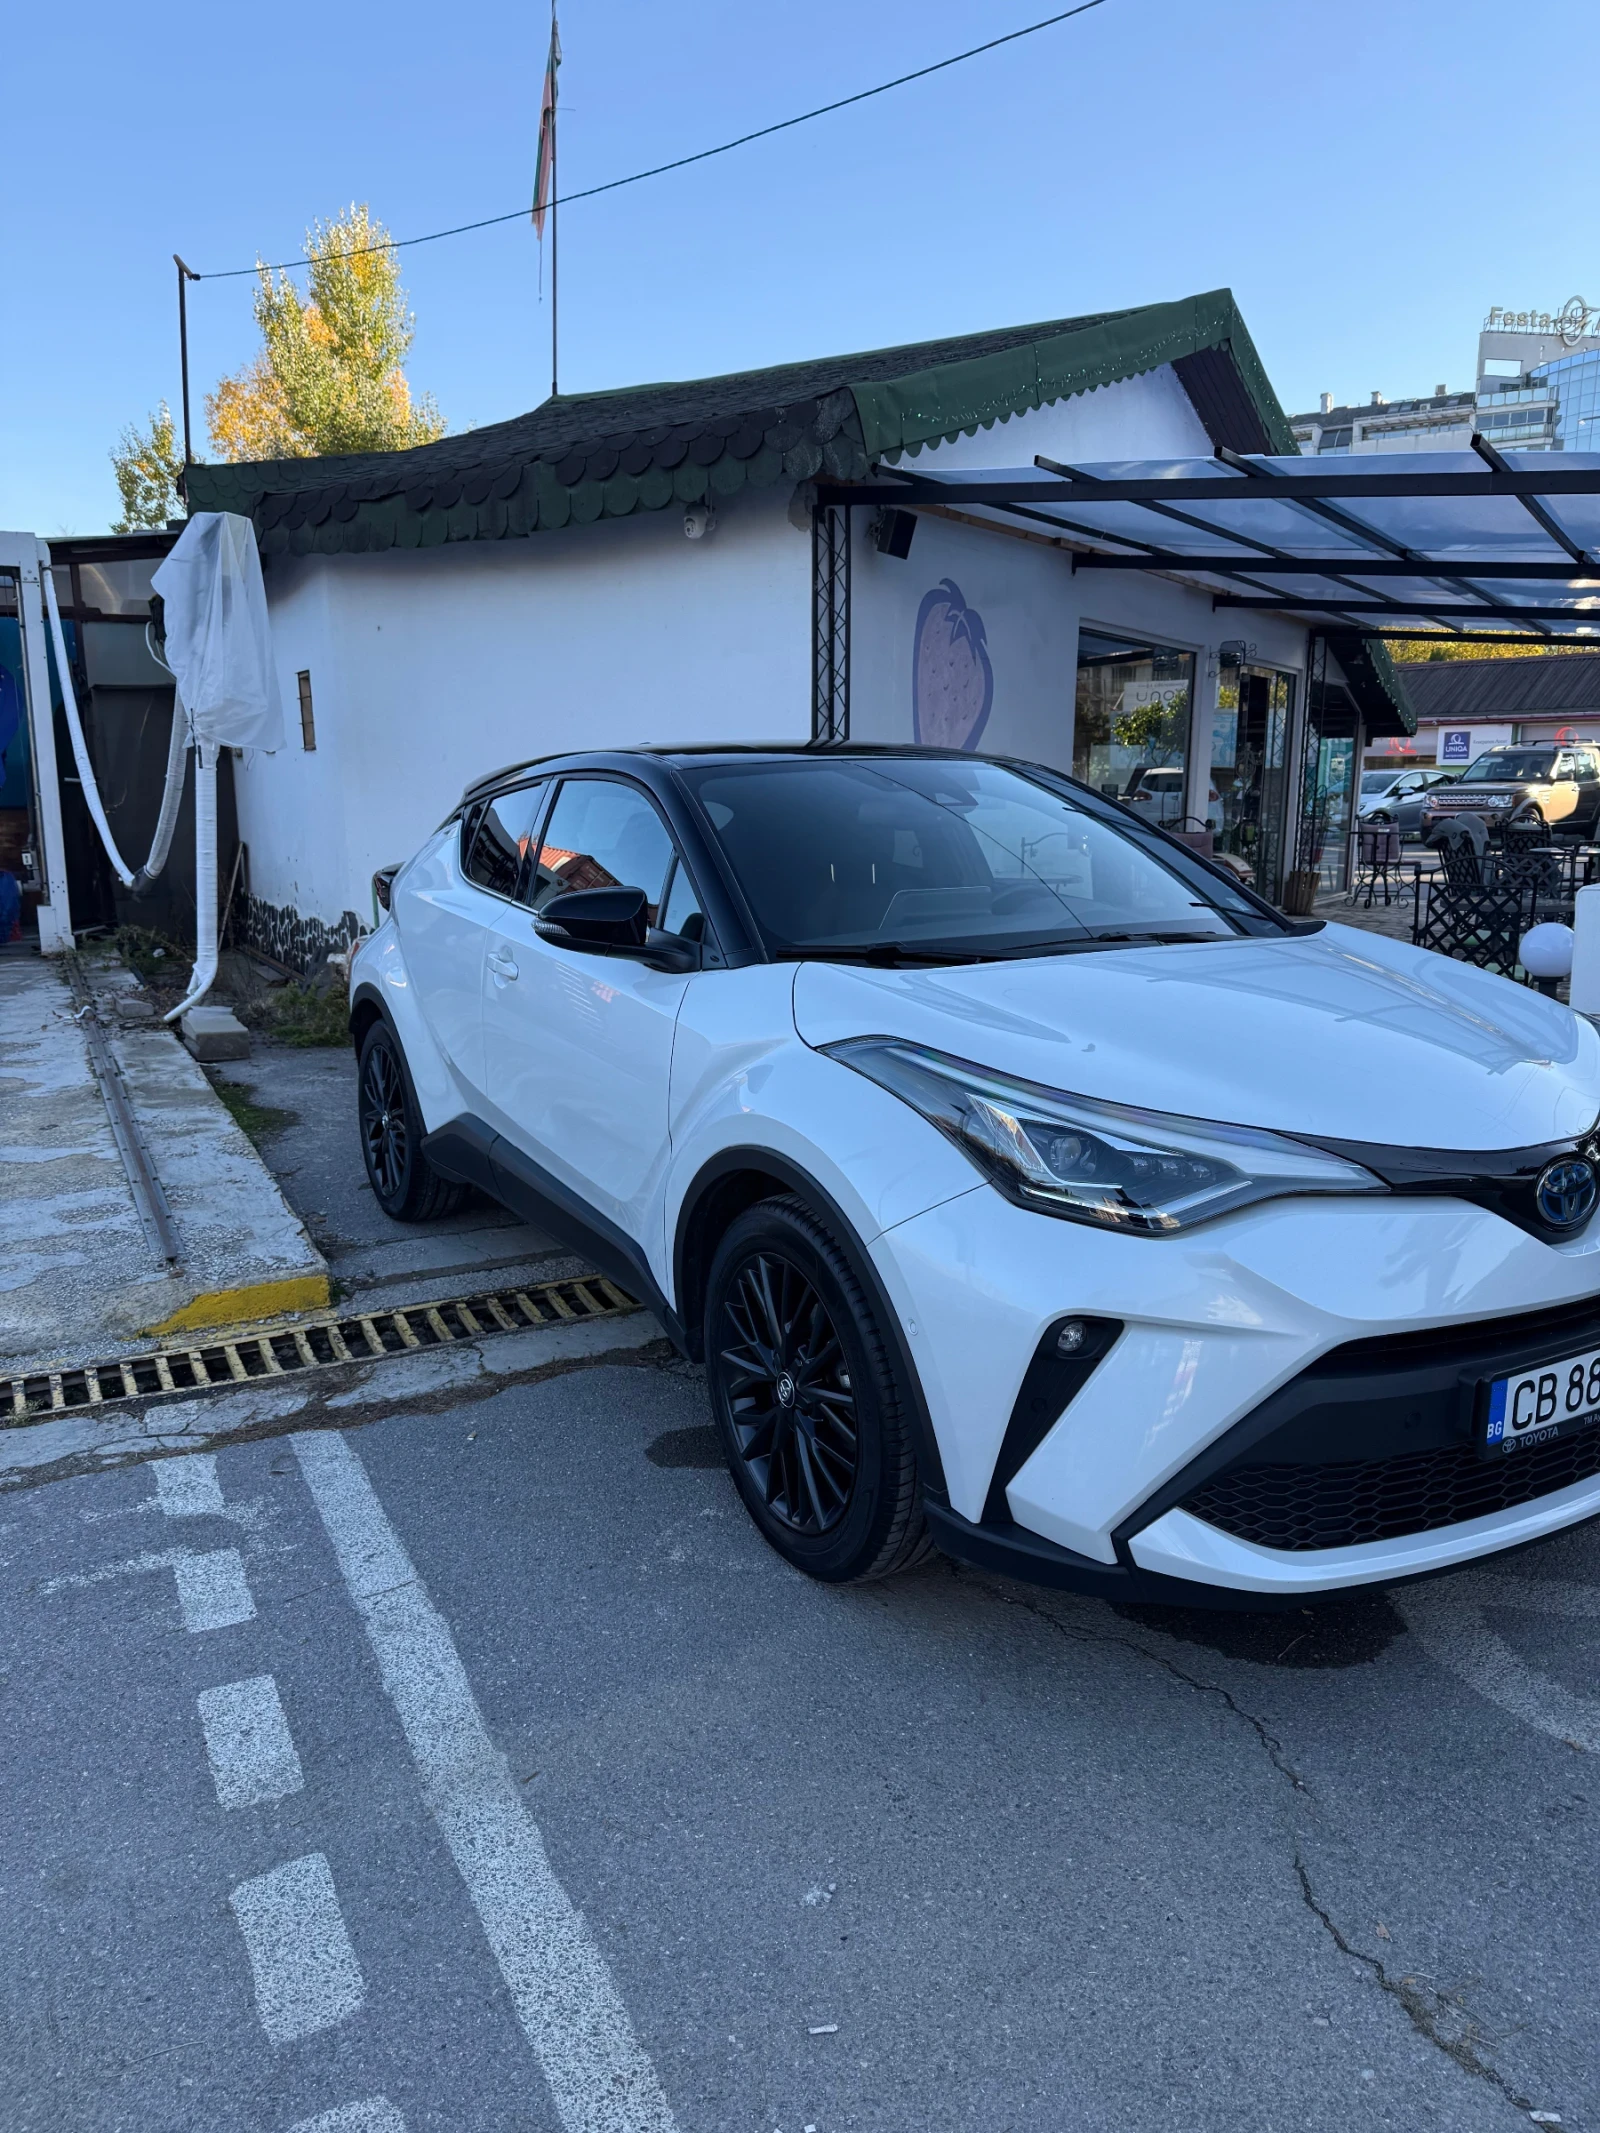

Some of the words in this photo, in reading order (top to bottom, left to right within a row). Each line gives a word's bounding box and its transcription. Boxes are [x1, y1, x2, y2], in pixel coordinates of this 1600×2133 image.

[1490, 306, 1551, 328] Festa
[1445, 744, 1468, 753] UNIQA
[1512, 1373, 1557, 1430] CB
[1487, 1421, 1502, 1438] BG
[1520, 1426, 1558, 1447] TOYOTA
